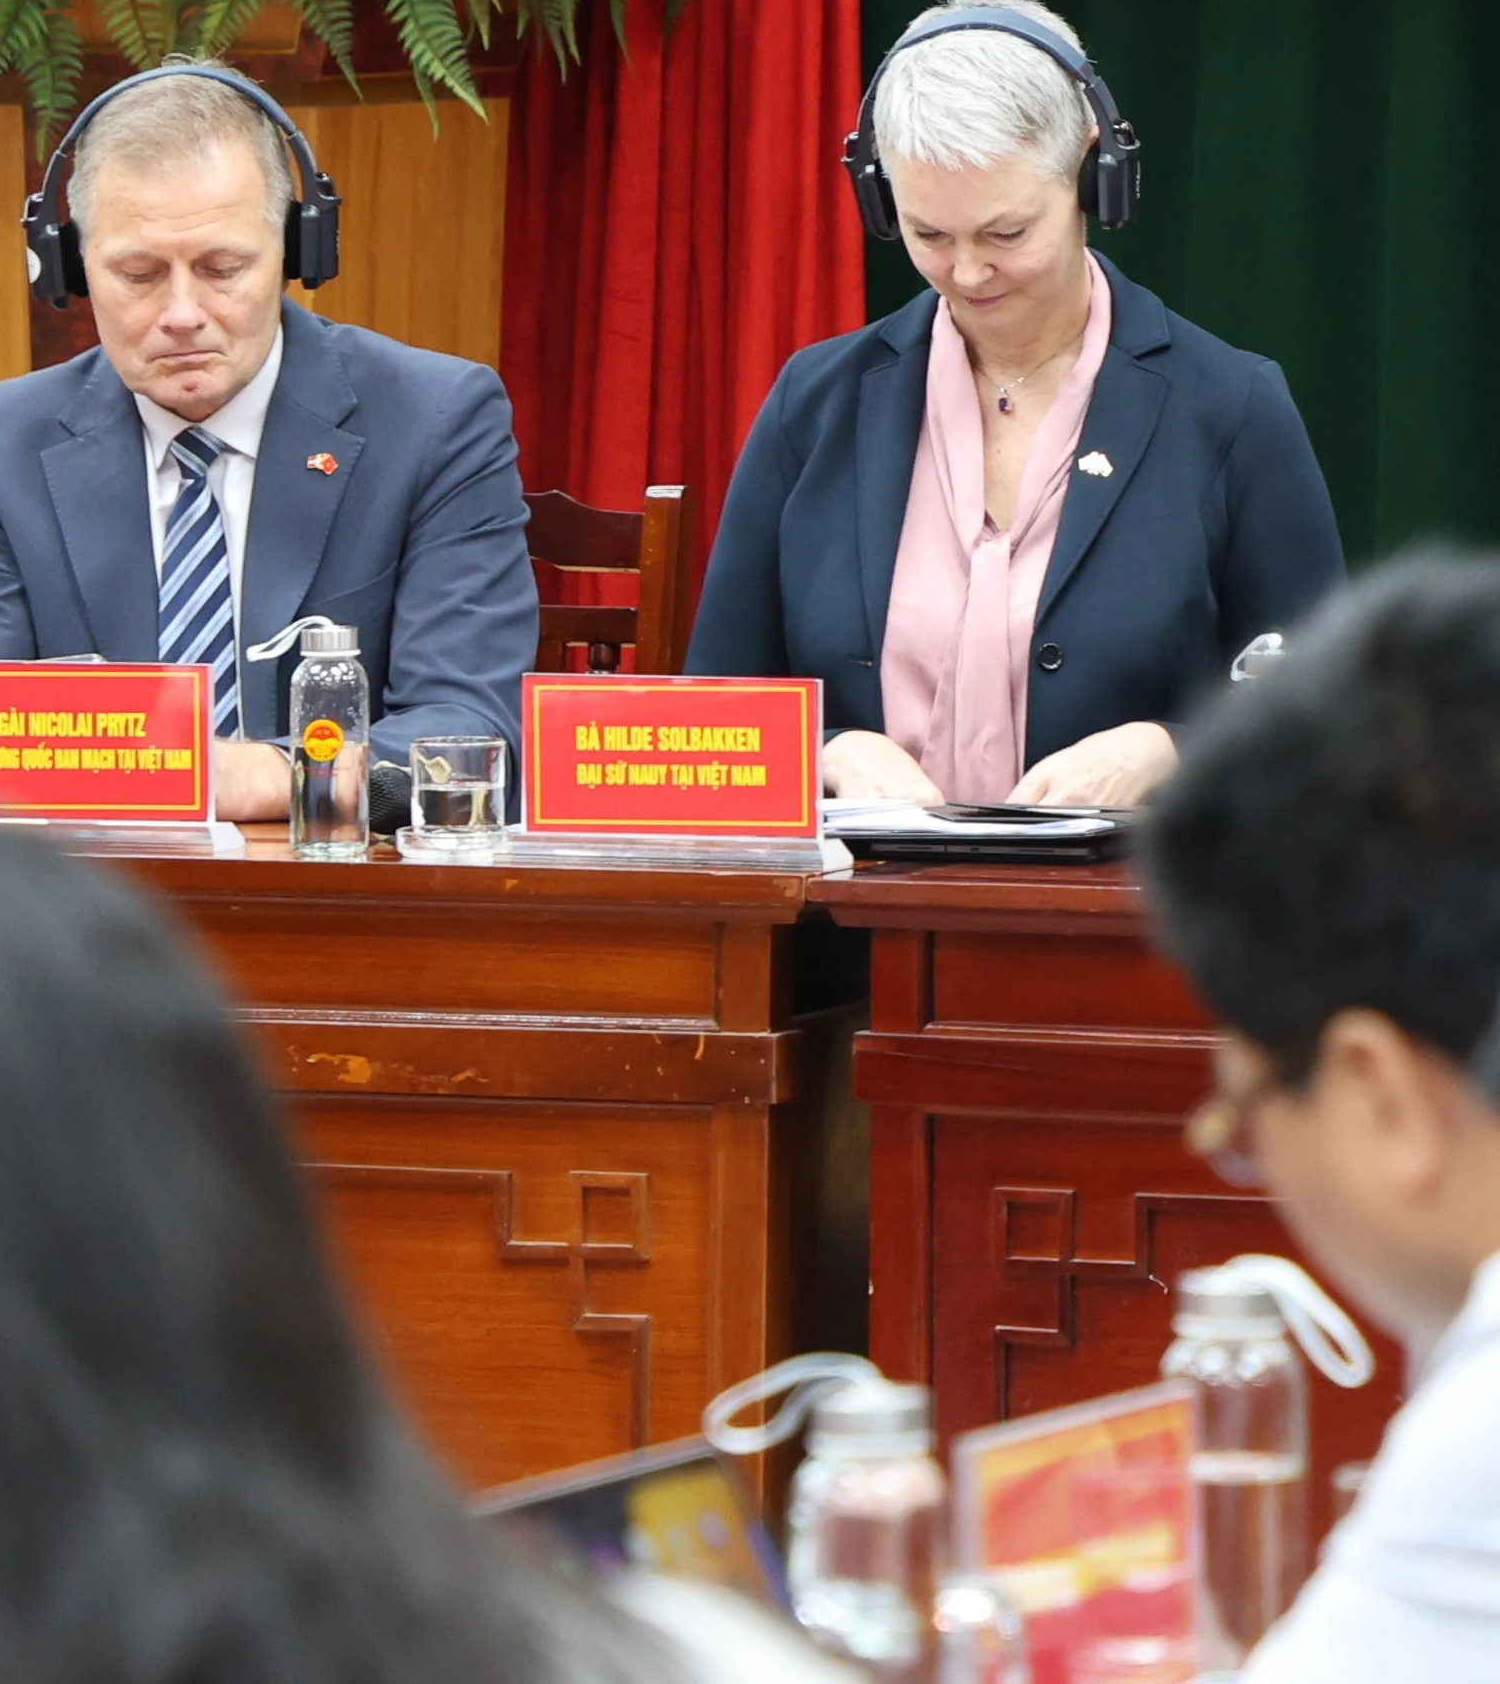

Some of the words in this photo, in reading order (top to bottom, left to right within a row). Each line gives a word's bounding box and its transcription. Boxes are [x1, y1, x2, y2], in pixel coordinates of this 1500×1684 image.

[28, 711, 94, 737] NICOLAI
[96, 712, 147, 738] PRYTZ
[603, 725, 654, 752] HILDE
[657, 726, 761, 753] SOLBAKKEN
[164, 748, 193, 770] NAM
[576, 763, 602, 790] ĐẠI
[629, 763, 668, 786] NAUY
[671, 764, 695, 790] TẠI
[696, 760, 729, 791] VIỆT
[731, 764, 767, 787] NAM
